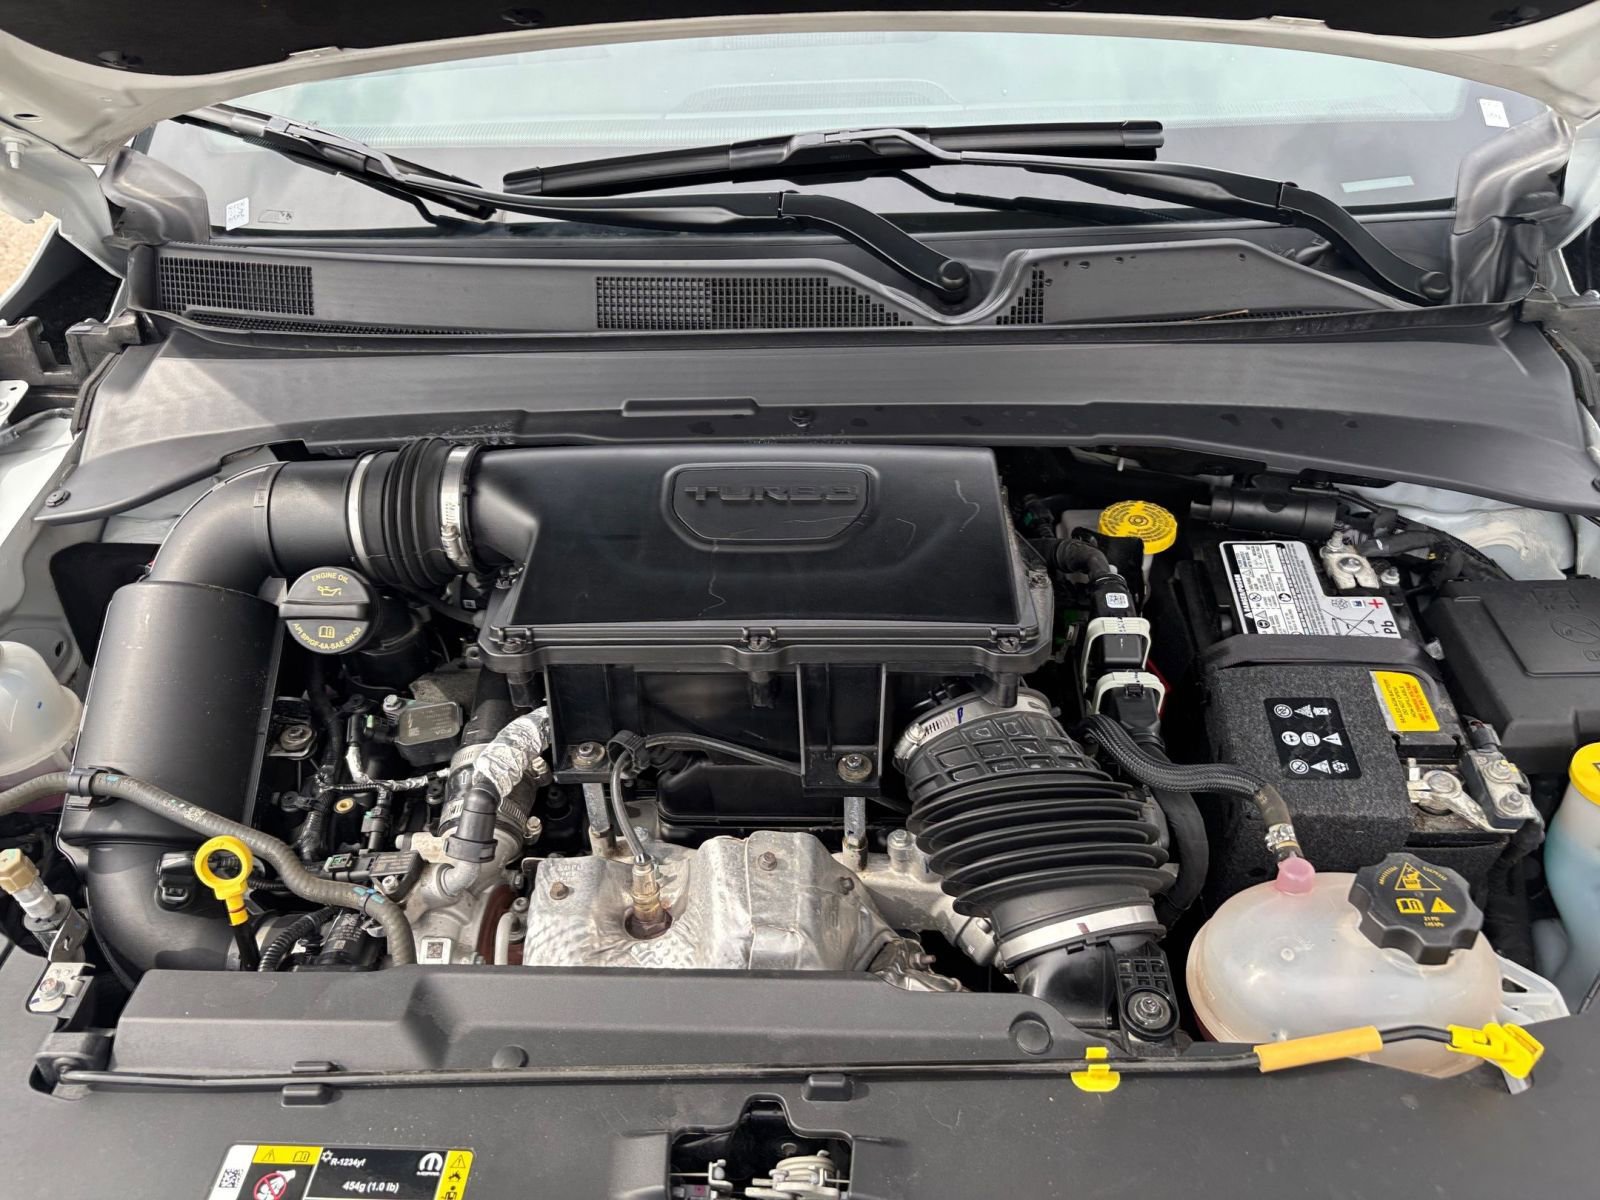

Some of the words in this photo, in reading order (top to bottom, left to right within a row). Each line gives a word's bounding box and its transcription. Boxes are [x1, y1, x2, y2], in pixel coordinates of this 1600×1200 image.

[684, 486, 859, 505] TURBO
[311, 572, 337, 582] ENGINE
[338, 574, 349, 584] OIL
[292, 623, 302, 634] API
[1381, 620, 1397, 635] Pb
[330, 1158, 366, 1168] R-1234yf
[342, 1181, 366, 1194] 454g
[367, 1182, 385, 1194] (1.0
[386, 1182, 399, 1194] lb)
